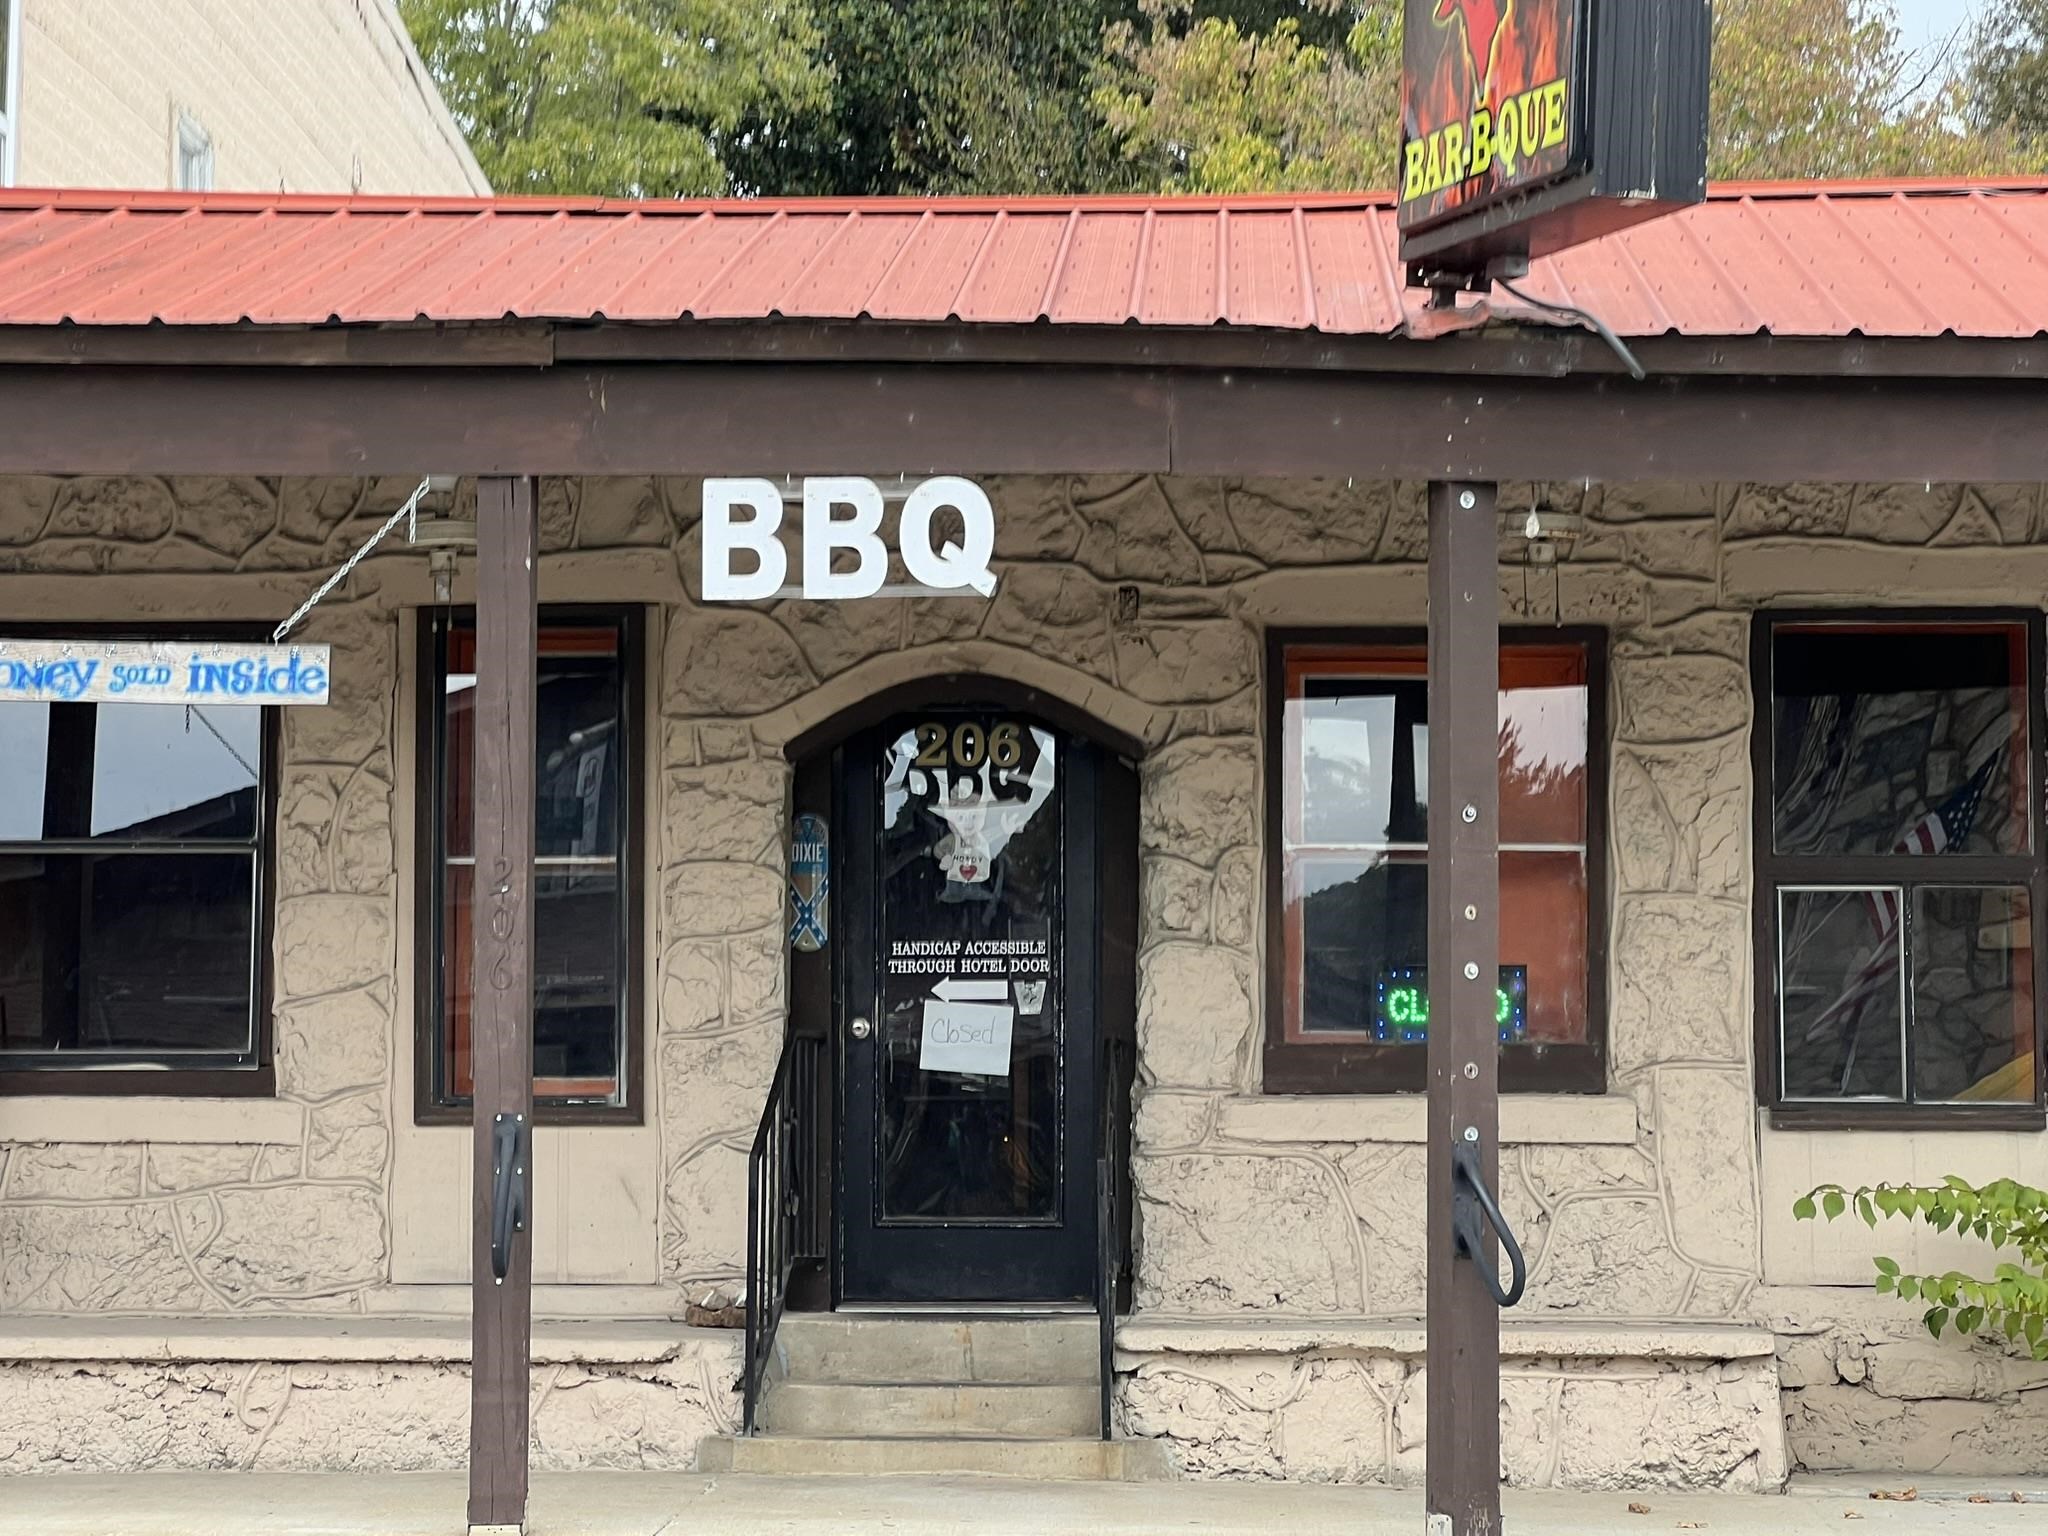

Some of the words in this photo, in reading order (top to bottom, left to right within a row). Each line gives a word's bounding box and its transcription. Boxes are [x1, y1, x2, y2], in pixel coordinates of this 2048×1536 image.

[701, 475, 998, 601] BBQ
[915, 722, 1022, 768] 206
[791, 842, 825, 863] DIXIE
[892, 940, 961, 956] HANDICAP
[964, 940, 1046, 956] ACCESSIBLE
[888, 958, 956, 974] THROUGH
[960, 958, 1007, 973] HOTEL
[1010, 958, 1049, 973] DOOR
